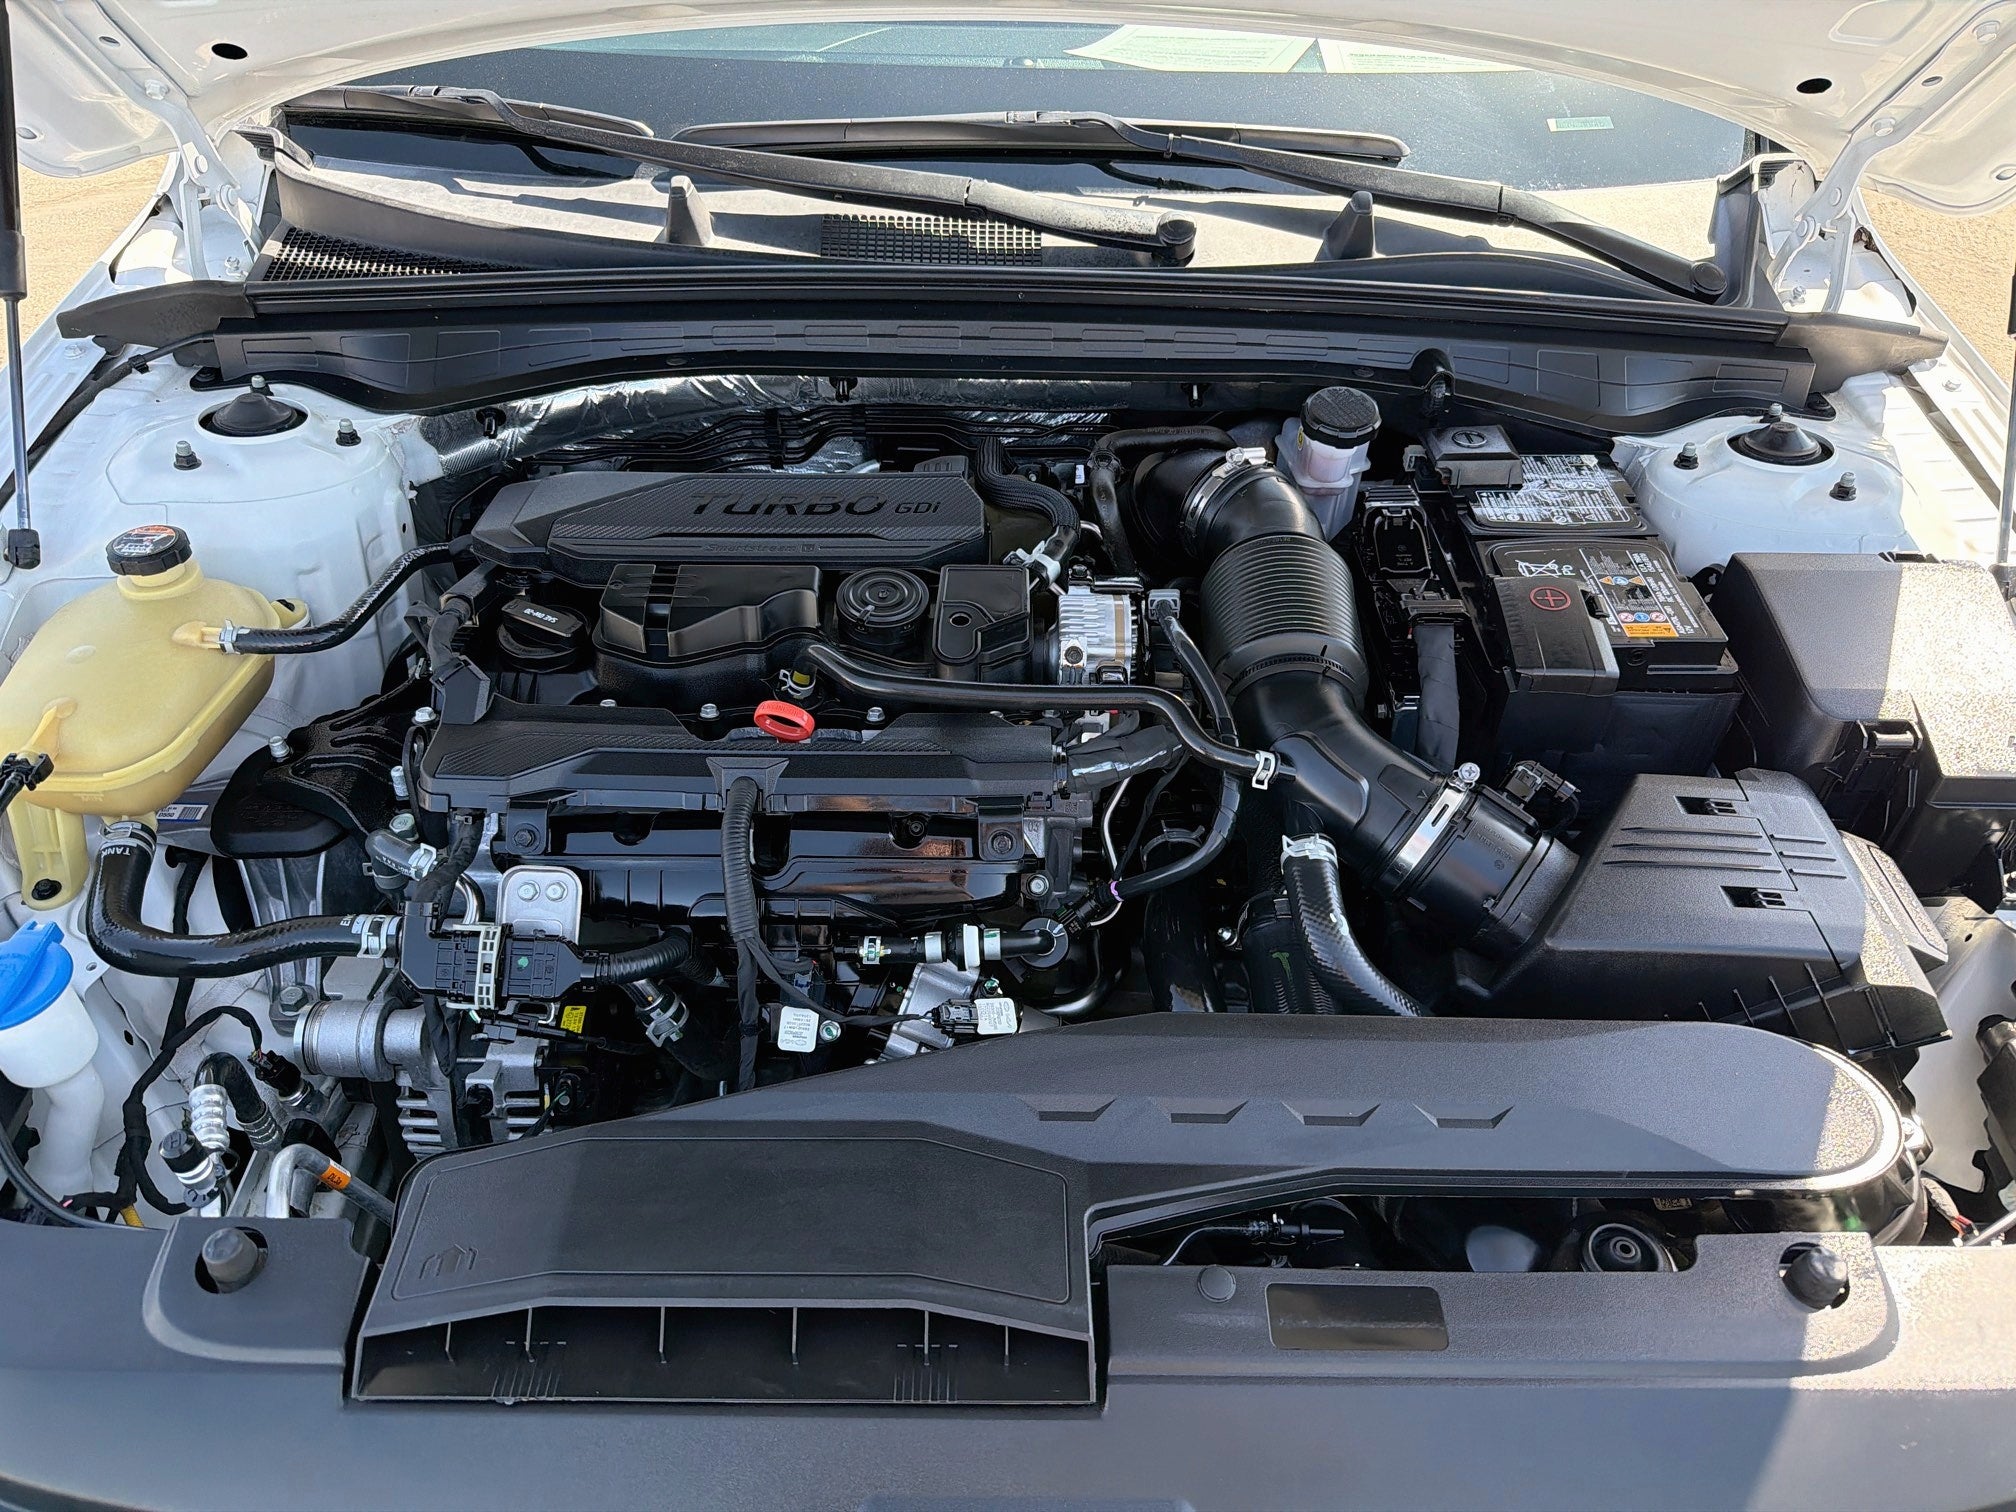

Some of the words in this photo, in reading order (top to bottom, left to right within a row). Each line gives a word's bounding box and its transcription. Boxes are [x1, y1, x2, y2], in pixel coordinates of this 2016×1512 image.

[691, 492, 887, 516] TURBO
[895, 501, 941, 515] GDi
[523, 608, 546, 618] 0W-20
[543, 614, 559, 623] SAE
[101, 846, 131, 856] TANK
